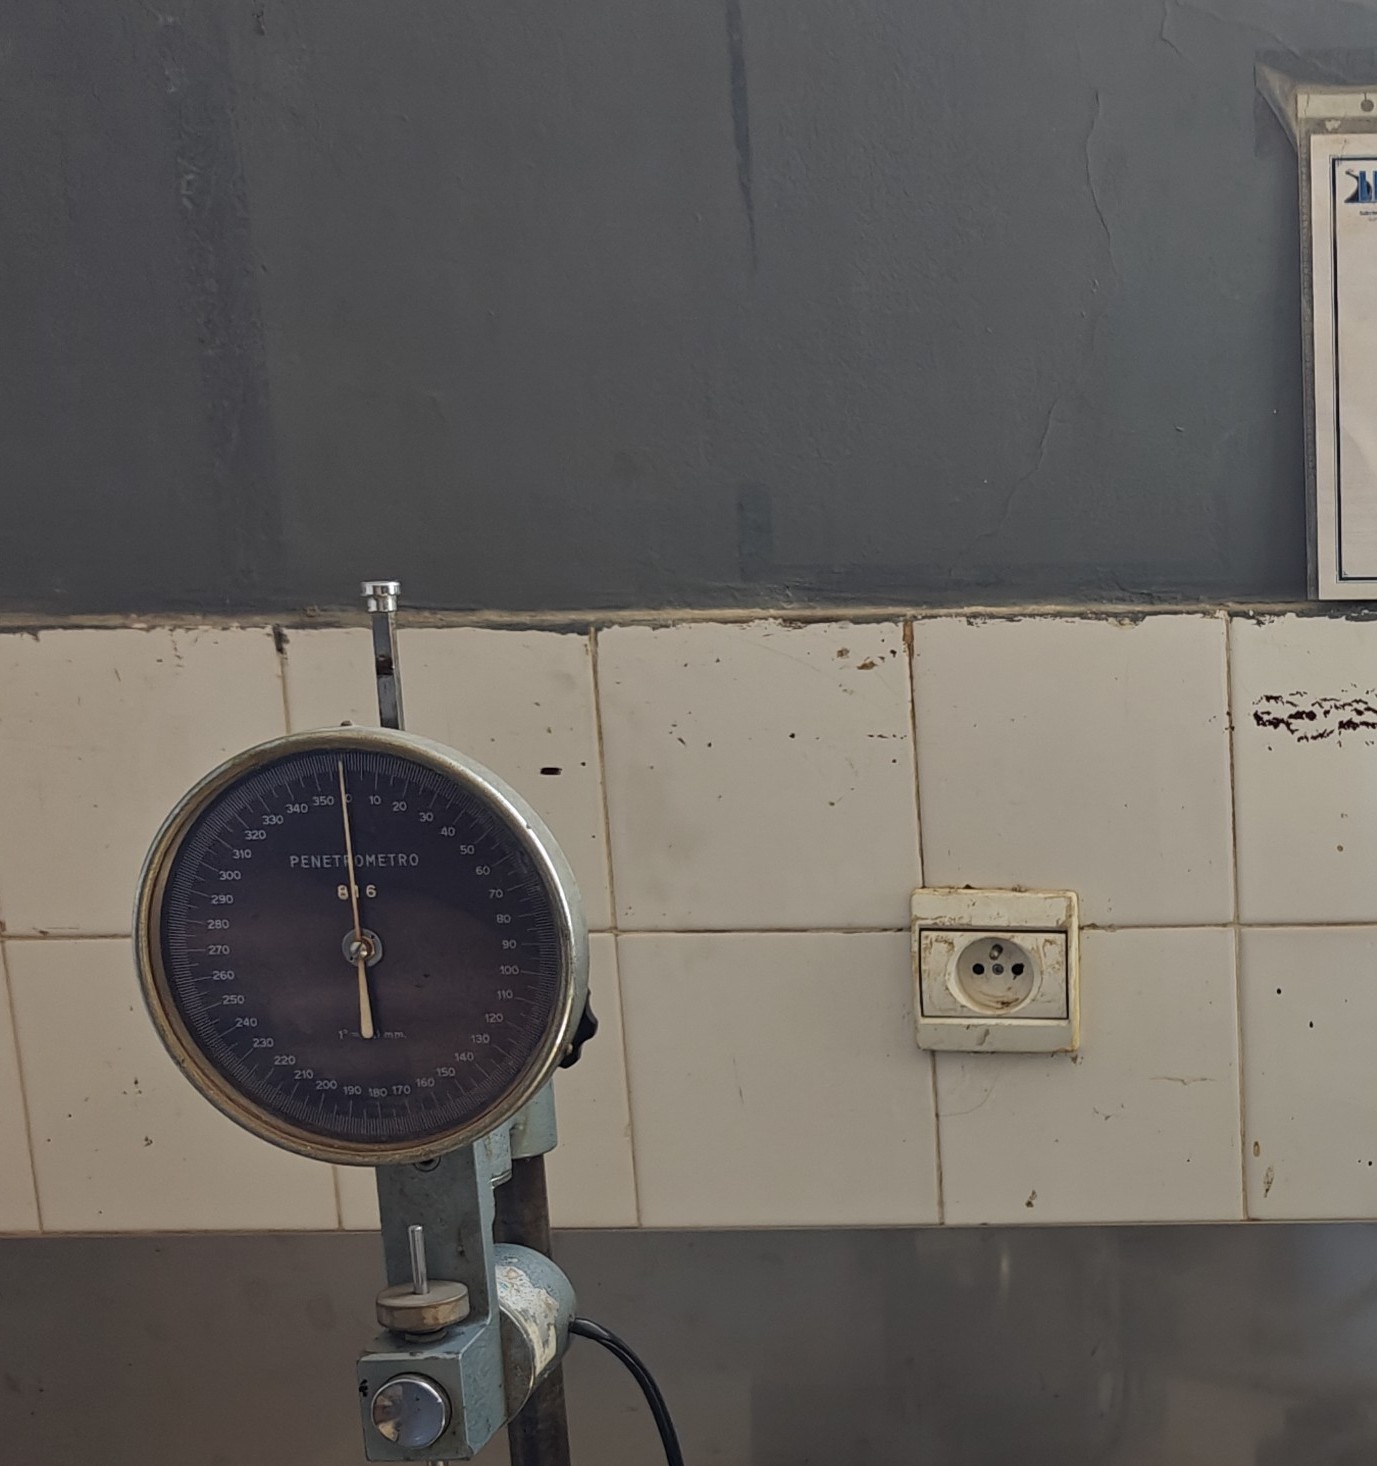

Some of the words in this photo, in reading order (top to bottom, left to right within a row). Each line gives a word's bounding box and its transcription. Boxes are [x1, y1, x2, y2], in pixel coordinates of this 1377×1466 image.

[312, 796, 335, 806] 350
[369, 795, 381, 805] 10
[286, 803, 308, 814] 340
[392, 801, 407, 812] 20
[263, 815, 284, 825] 330
[419, 812, 434, 822] 30
[245, 830, 266, 840] 320
[441, 827, 456, 837] 40
[233, 849, 252, 859] 310
[460, 845, 475, 855] 50
[220, 870, 241, 880] 300
[476, 865, 491, 876] 60
[488, 889, 504, 899] 70
[211, 894, 234, 905] 290
[207, 919, 230, 929] 280
[497, 914, 511, 924] 80
[209, 944, 230, 955] 270
[502, 939, 516, 950] 90
[213, 970, 235, 981] 260
[500, 965, 519, 976] 100
[223, 995, 245, 1005] 250
[497, 990, 513, 1000] 110
[236, 1017, 257, 1028] 240
[485, 1013, 504, 1023] 120
[253, 1038, 274, 1048] 230
[471, 1034, 490, 1044] 130
[274, 1055, 295, 1066] 220
[455, 1052, 474, 1062] 140
[294, 1069, 313, 1080] 210
[437, 1067, 455, 1077] 150
[316, 1080, 337, 1090] 200
[416, 1078, 435, 1088] 160
[343, 1085, 362, 1096] 190
[369, 1087, 387, 1098] 180
[392, 1085, 411, 1095] 170
